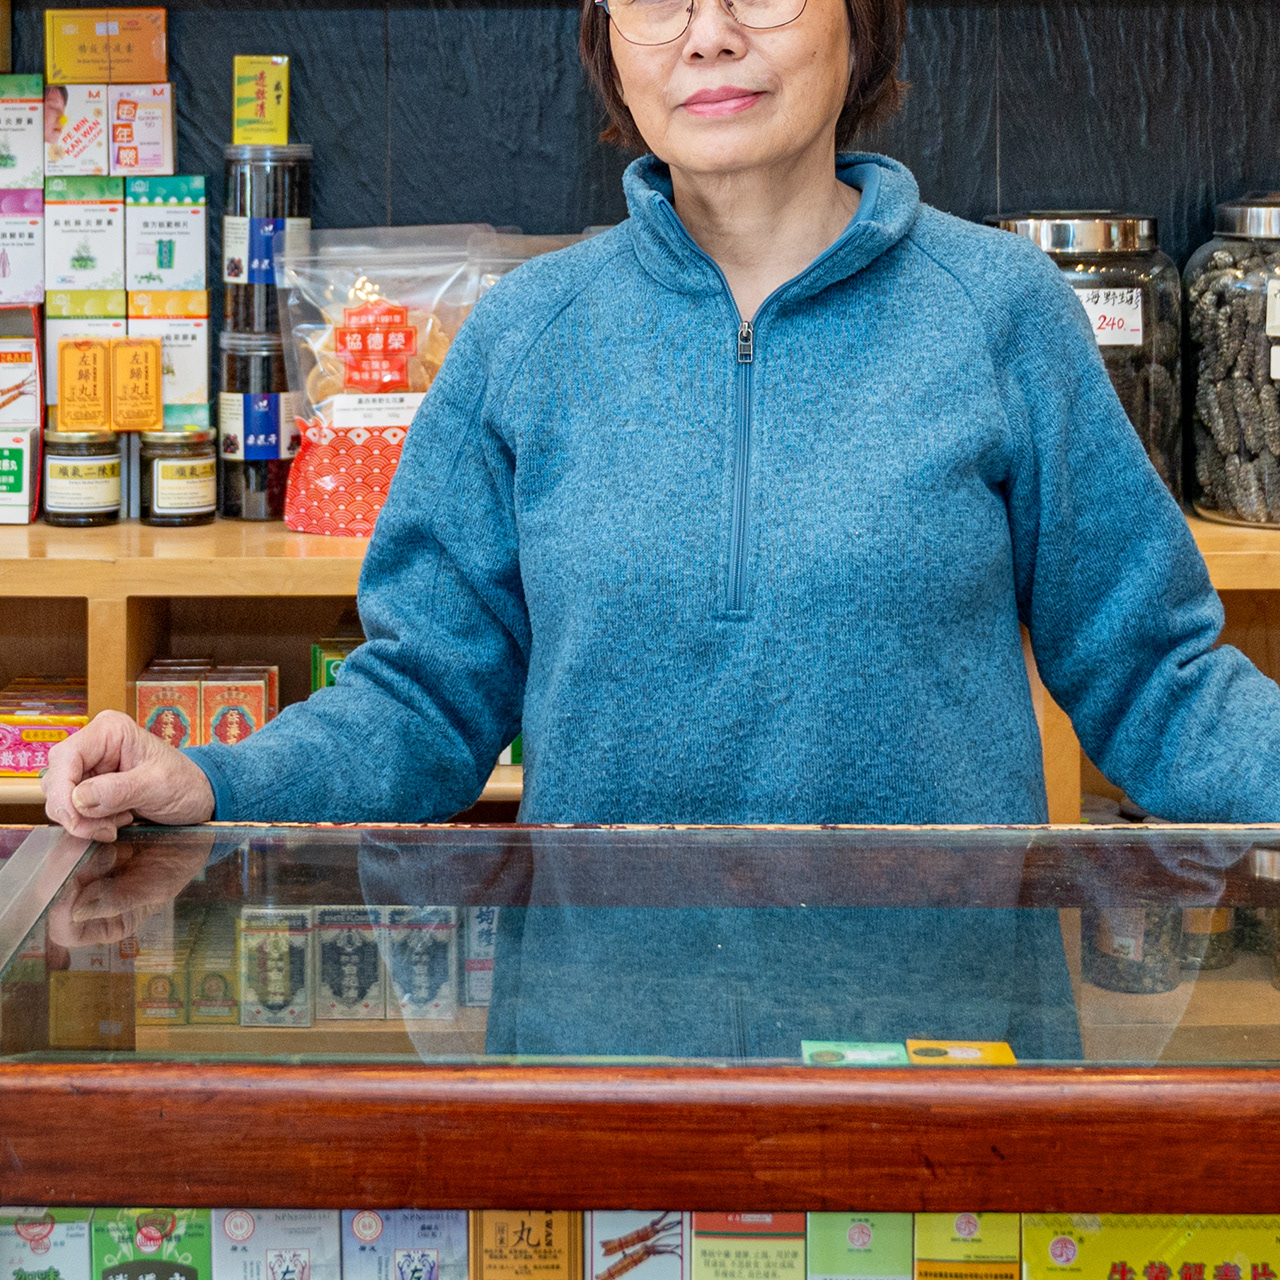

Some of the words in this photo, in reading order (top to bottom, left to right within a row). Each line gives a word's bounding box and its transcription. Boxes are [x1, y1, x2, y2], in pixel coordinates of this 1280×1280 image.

[62, 130, 74, 144] PE
[72, 117, 89, 135] MIN
[64, 136, 84, 156] KAN
[81, 119, 100, 140] WAN
[345, 332, 406, 351] 協德榮
[77, 352, 92, 397] 左歸丸
[128, 352, 144, 397] 左歸丸
[514, 1220, 540, 1248] 丸
